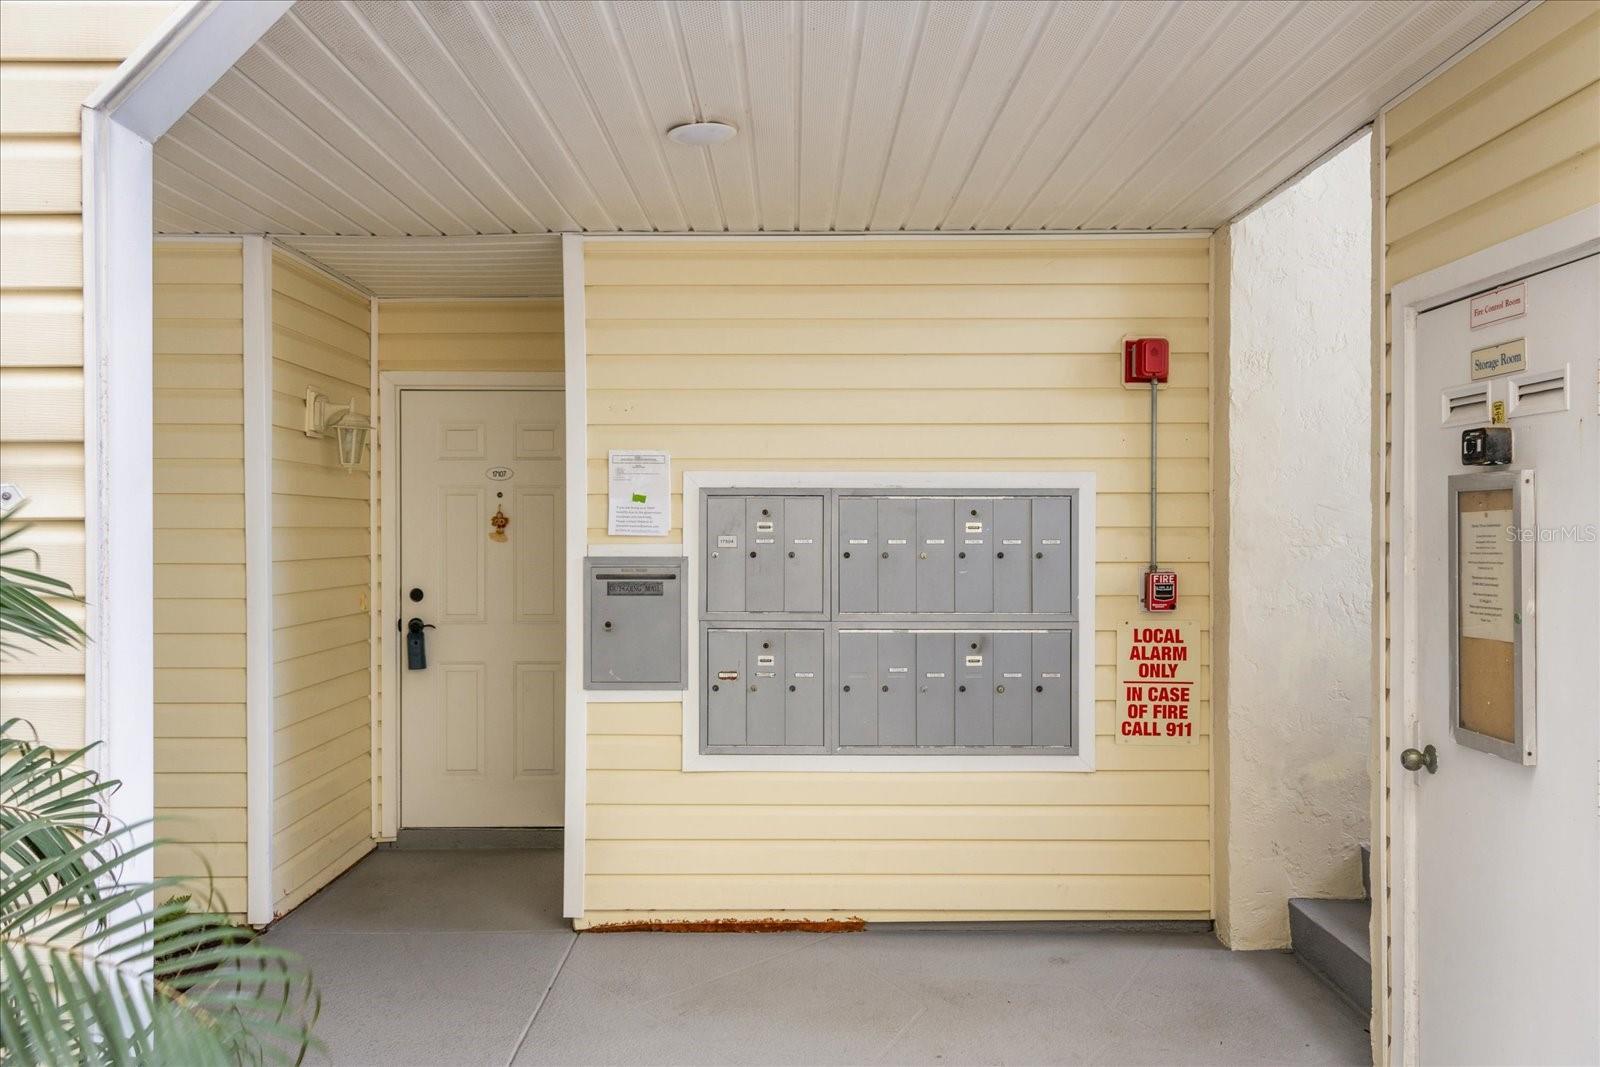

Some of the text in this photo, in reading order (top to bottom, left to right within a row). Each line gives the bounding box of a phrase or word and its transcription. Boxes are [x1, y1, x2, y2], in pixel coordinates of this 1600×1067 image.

[1474, 298, 1521, 317] Fire Control Room
[1474, 352, 1522, 372] Storage Room
[1153, 575, 1175, 583] FIRE
[1133, 628, 1184, 644] LOCAL
[1129, 646, 1187, 661] ALARM
[1138, 663, 1178, 678] ONLY
[1126, 686, 1190, 702] IN CASE
[1128, 704, 1188, 720] OF FIRE
[1121, 722, 1192, 736] CALL 911
